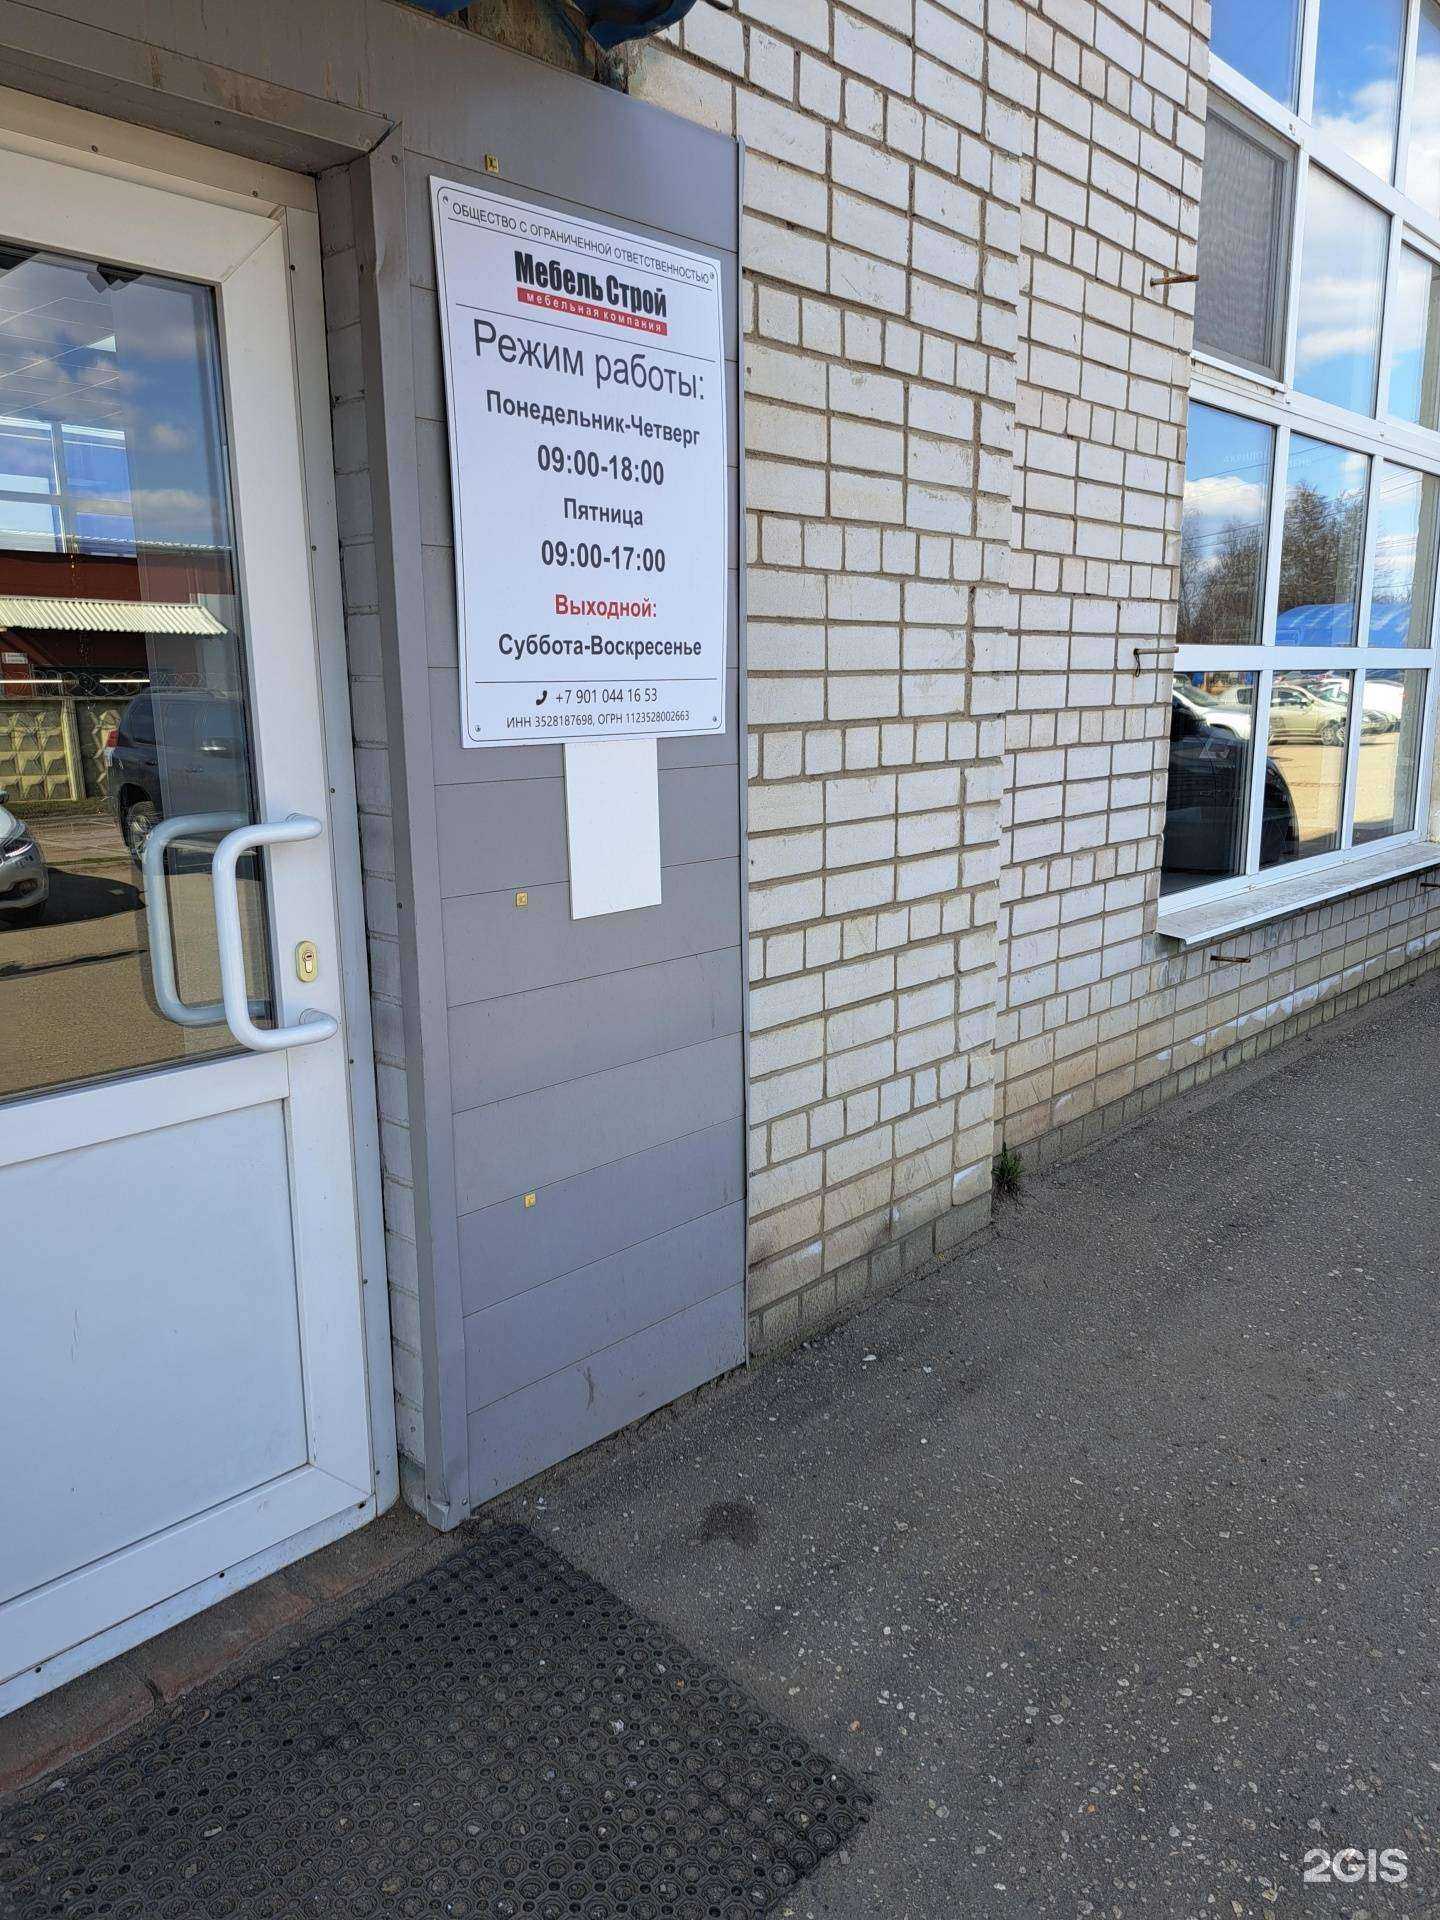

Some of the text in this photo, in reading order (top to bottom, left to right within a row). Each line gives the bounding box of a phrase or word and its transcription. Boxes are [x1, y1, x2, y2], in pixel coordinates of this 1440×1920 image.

[452, 202, 709, 285] ОБЩЕСТВО С ОГРАНИЧЕННОЙ ОТВЕТСТВЕННОСТЬЮ
[527, 293, 661, 332] мебельная компания
[473, 318, 705, 400] Режим работы:
[486, 389, 701, 448] Понедельник-Четверг
[537, 444, 664, 486] 09:00-18:00
[563, 497, 643, 528] Пятница
[541, 540, 666, 572] 09:00-17:00
[555, 593, 657, 619] Выходной:
[498, 633, 702, 660] Суббота-Воскресенье
[555, 688, 658, 704] +7 901 044 16 53
[506, 716, 532, 728] ИНН
[597, 712, 623, 725] ОГРН
